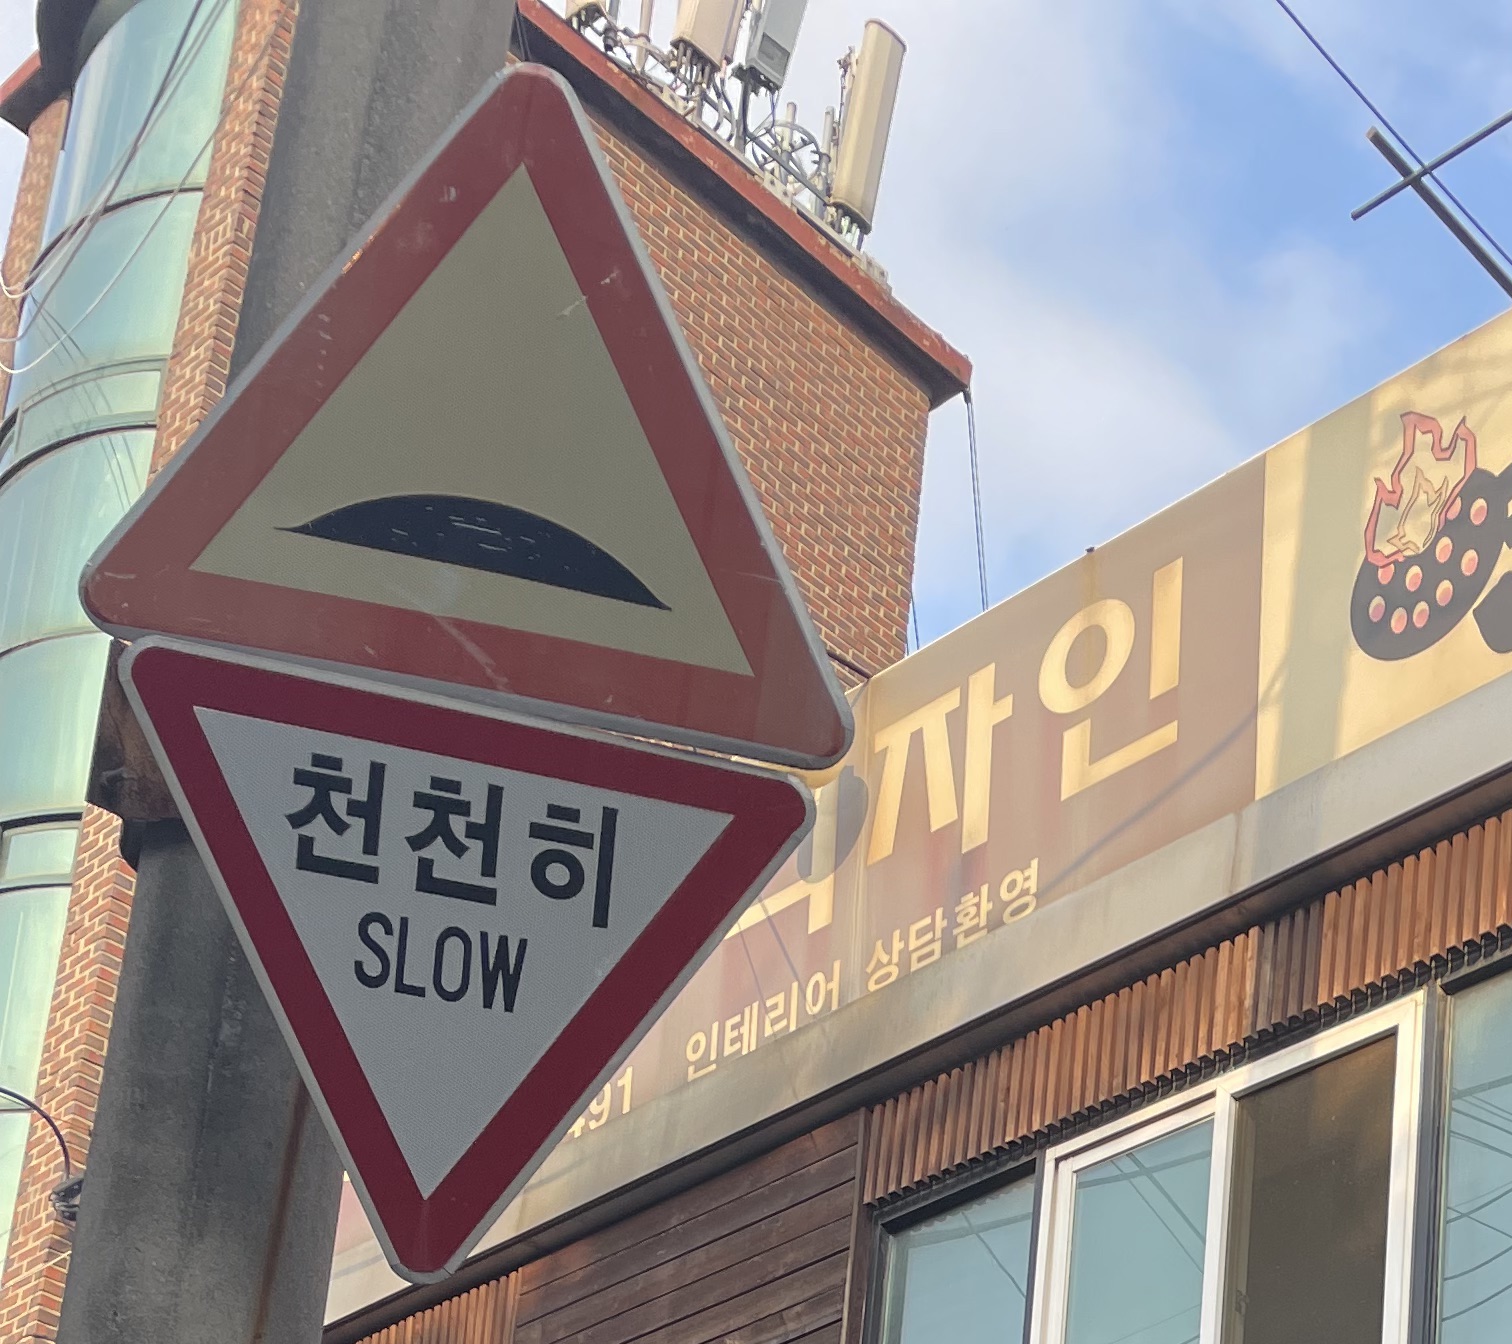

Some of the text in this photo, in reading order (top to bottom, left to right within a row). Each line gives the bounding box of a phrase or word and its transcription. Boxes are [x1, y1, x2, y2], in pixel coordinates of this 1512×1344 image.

[283, 752, 619, 929] 천천히
[353, 912, 528, 1013] SLOW
[685, 959, 842, 1082] 인테리어
